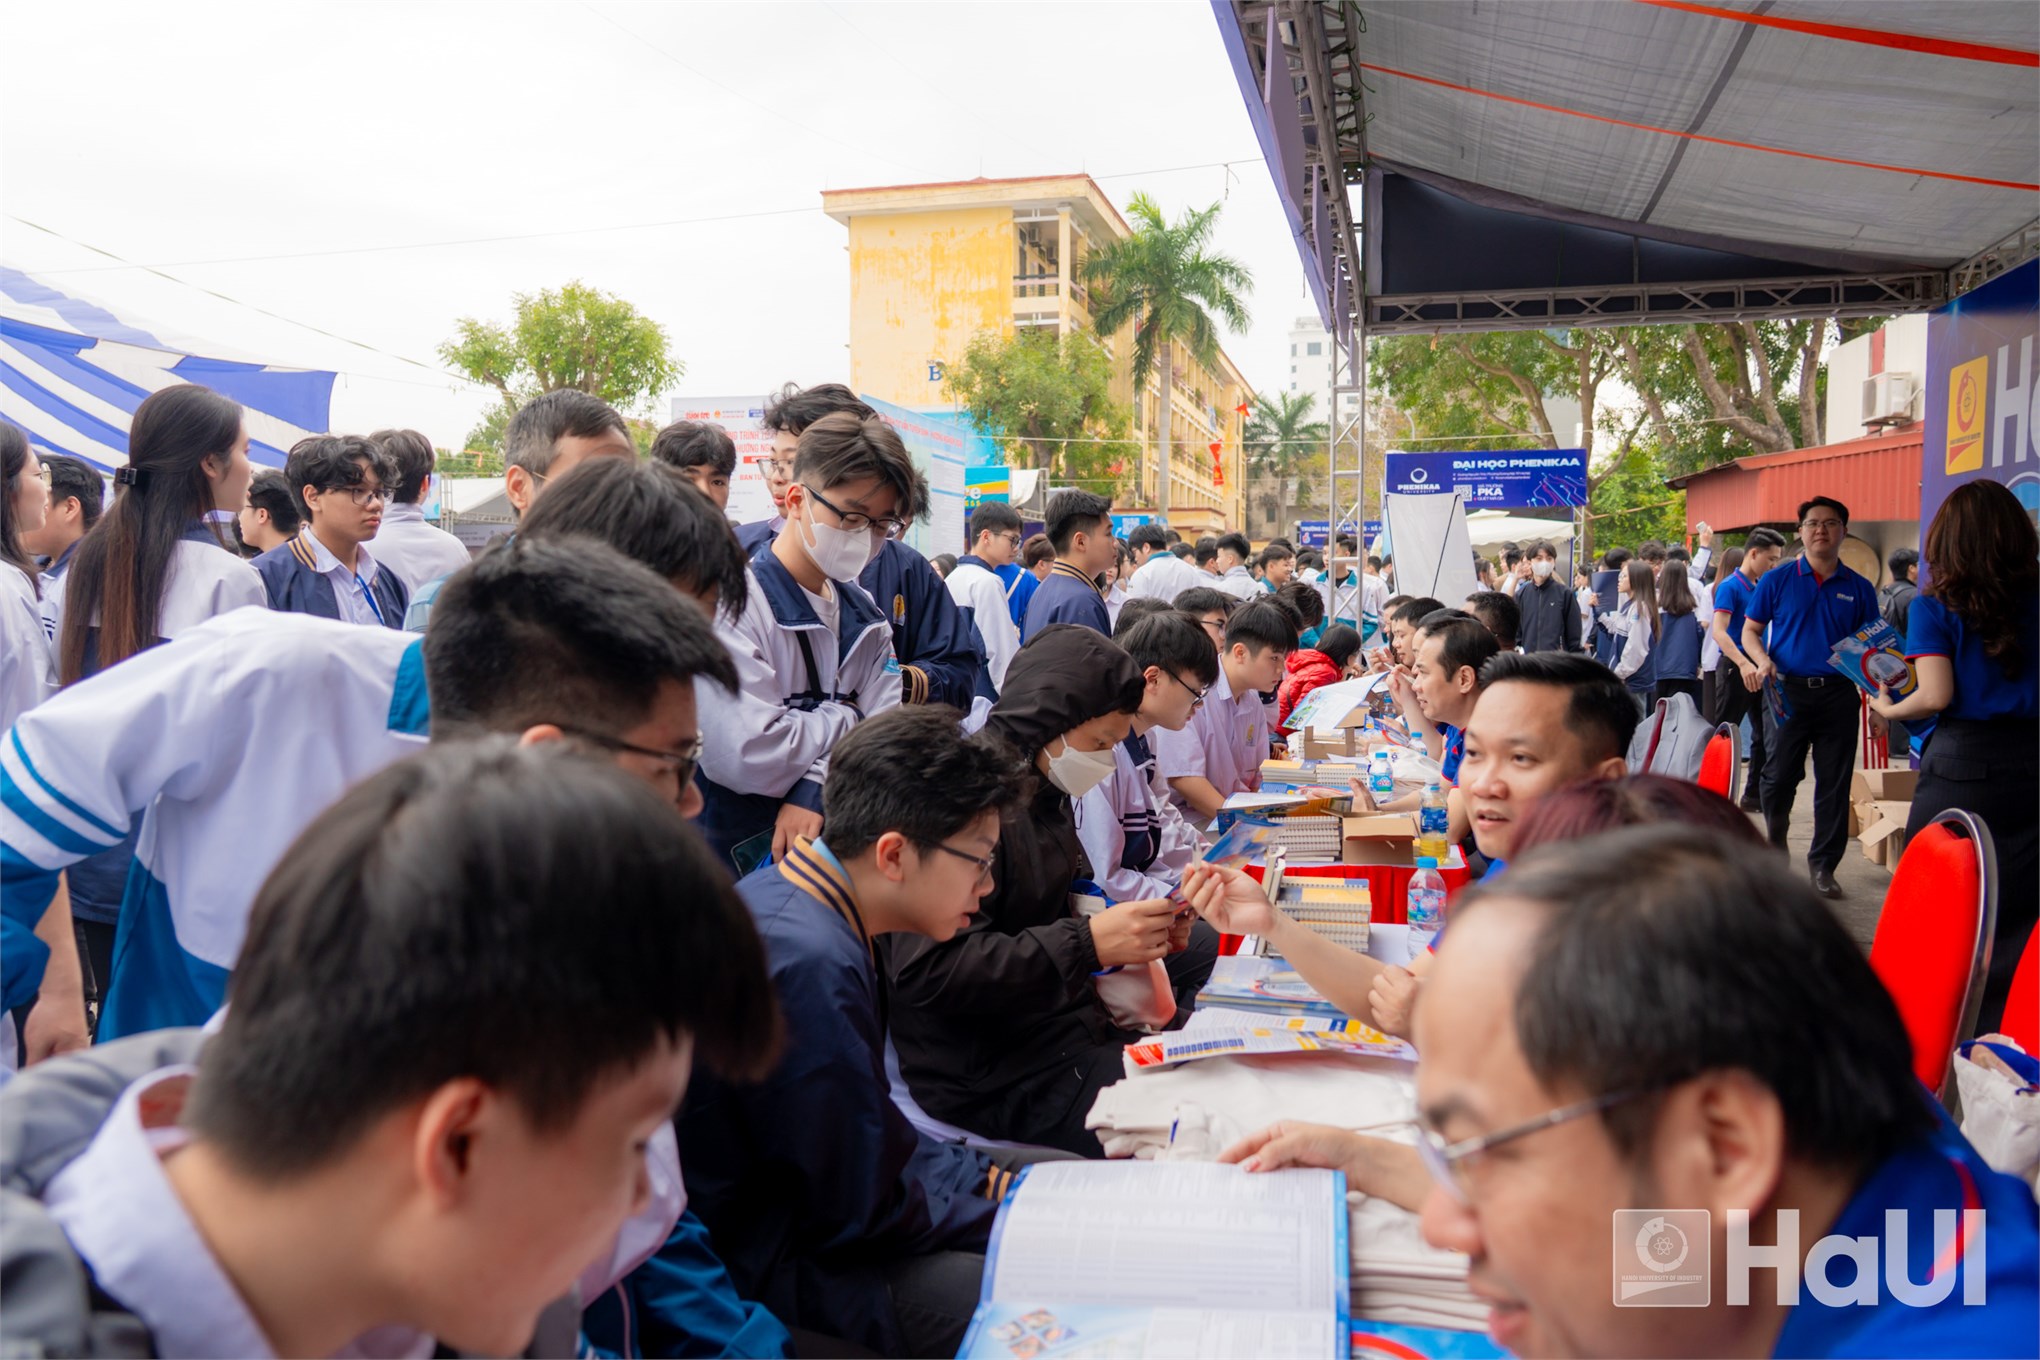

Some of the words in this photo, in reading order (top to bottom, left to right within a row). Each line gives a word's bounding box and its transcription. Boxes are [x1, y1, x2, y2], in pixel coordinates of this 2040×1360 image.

[1453, 460, 1475, 471] ĐẠI
[1477, 459, 1507, 471] HỌC
[1509, 457, 1580, 468] PHENIKAA
[1477, 487, 1503, 496] PKA
